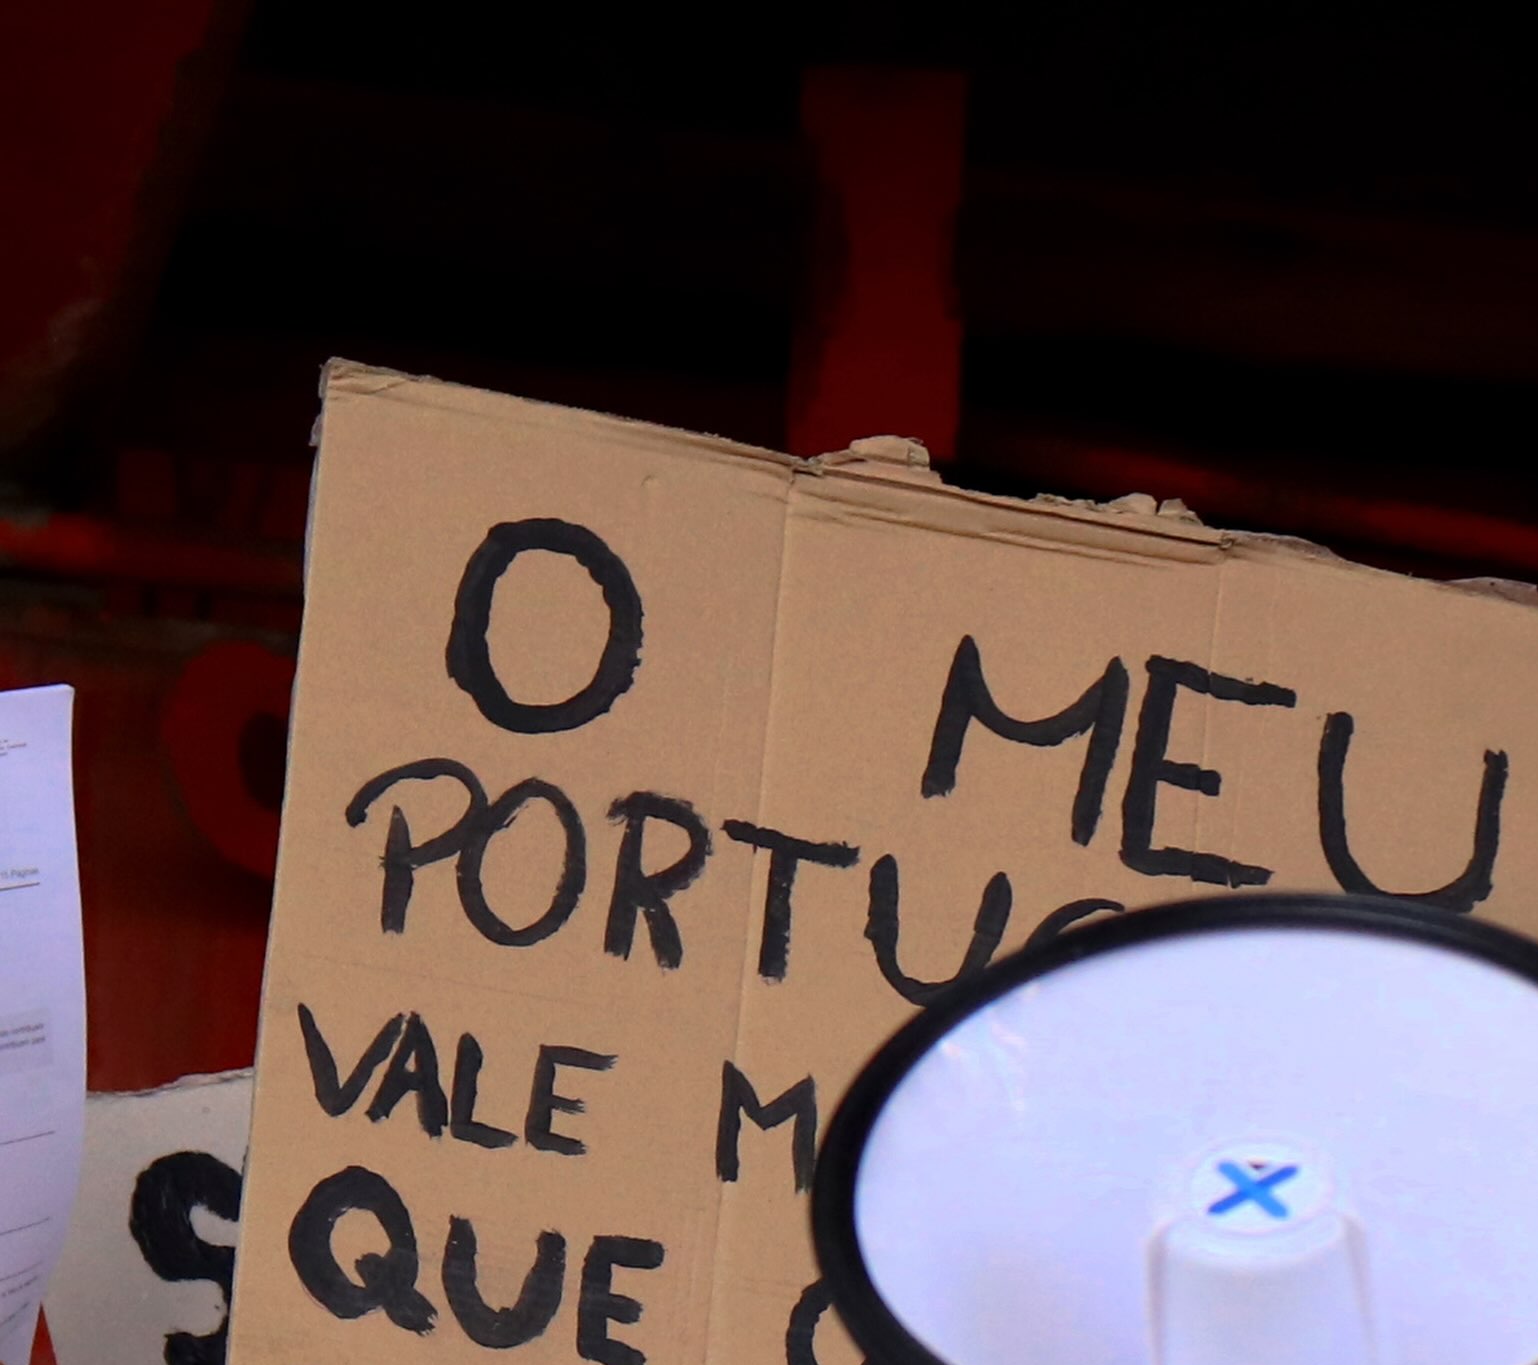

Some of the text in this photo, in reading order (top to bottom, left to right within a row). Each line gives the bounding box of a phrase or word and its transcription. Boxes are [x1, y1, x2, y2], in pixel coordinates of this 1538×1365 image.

[446, 517, 1509, 914] O MEU
[345, 757, 1126, 1008] PORTU
[297, 1002, 619, 1156] VALE
